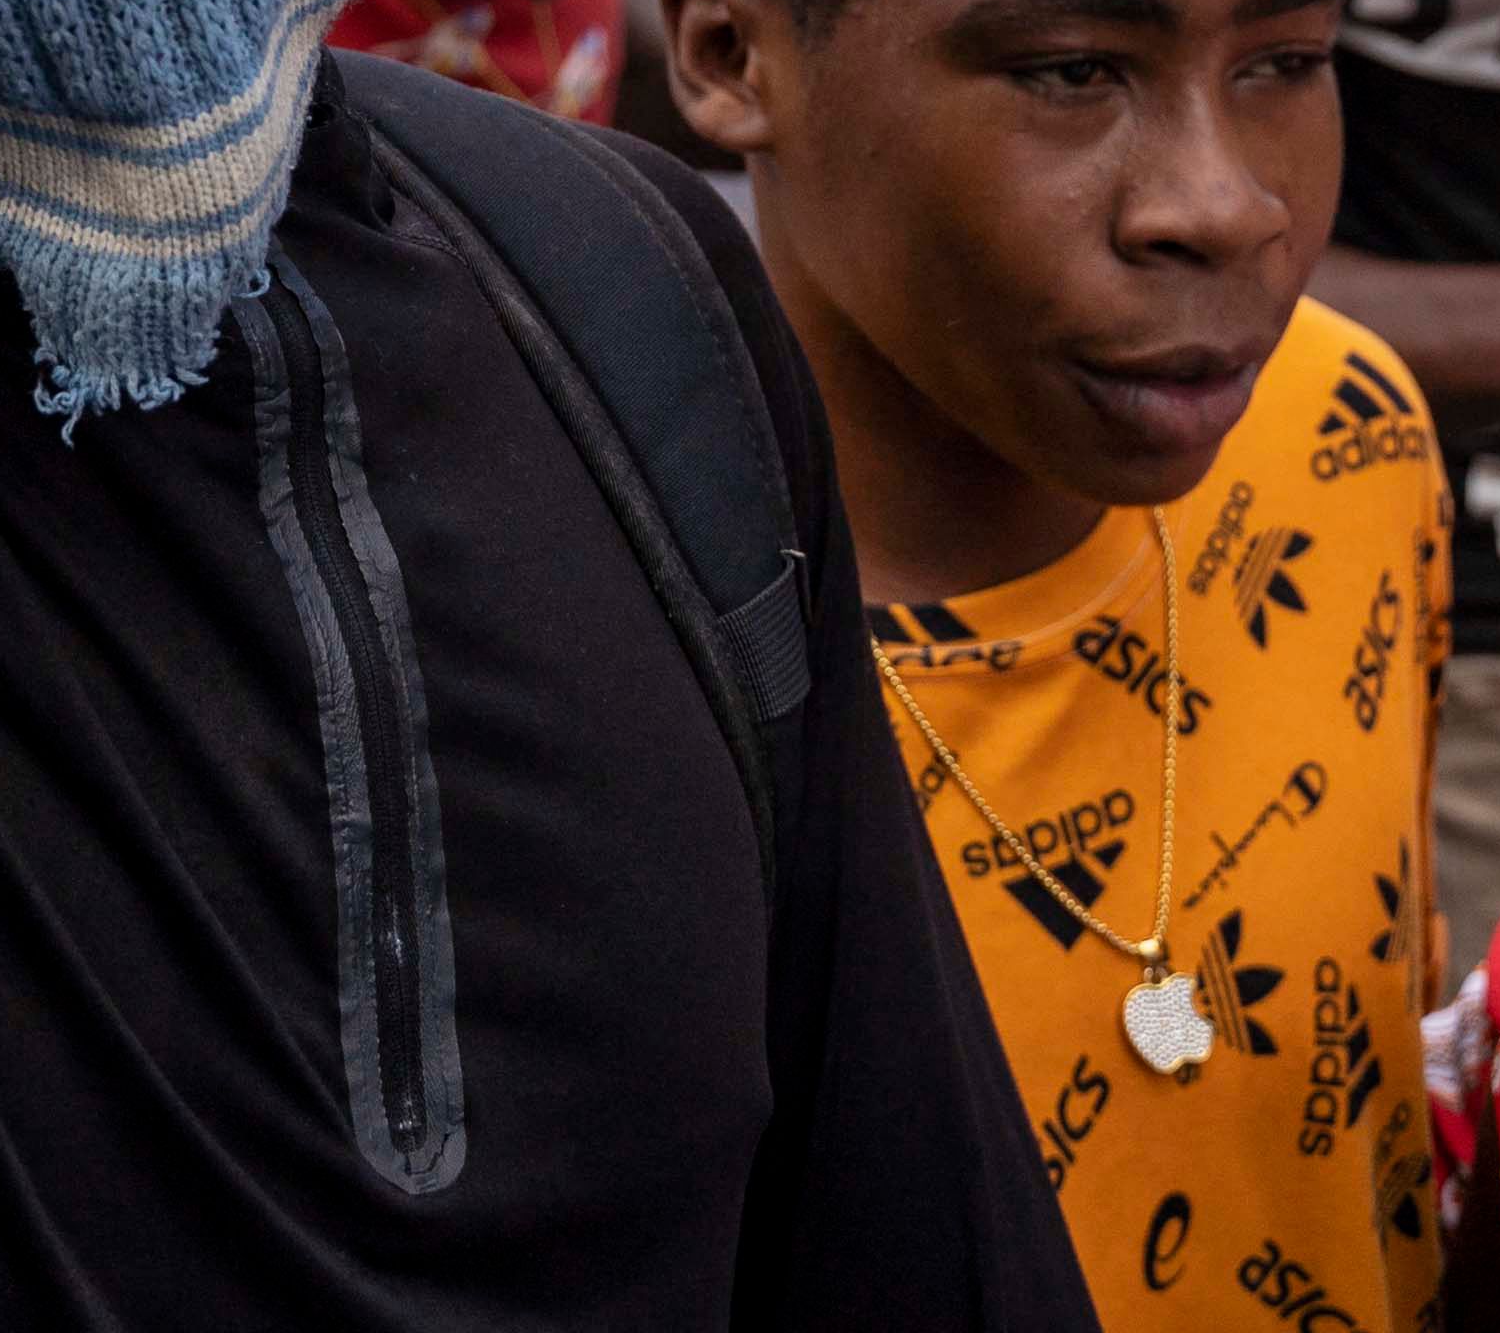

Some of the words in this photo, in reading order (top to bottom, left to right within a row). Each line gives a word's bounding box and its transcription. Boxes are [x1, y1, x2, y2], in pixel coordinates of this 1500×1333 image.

[1073, 615, 1212, 735] asics
[961, 787, 1136, 877] adidas
[1299, 955, 1347, 1157] adidas
